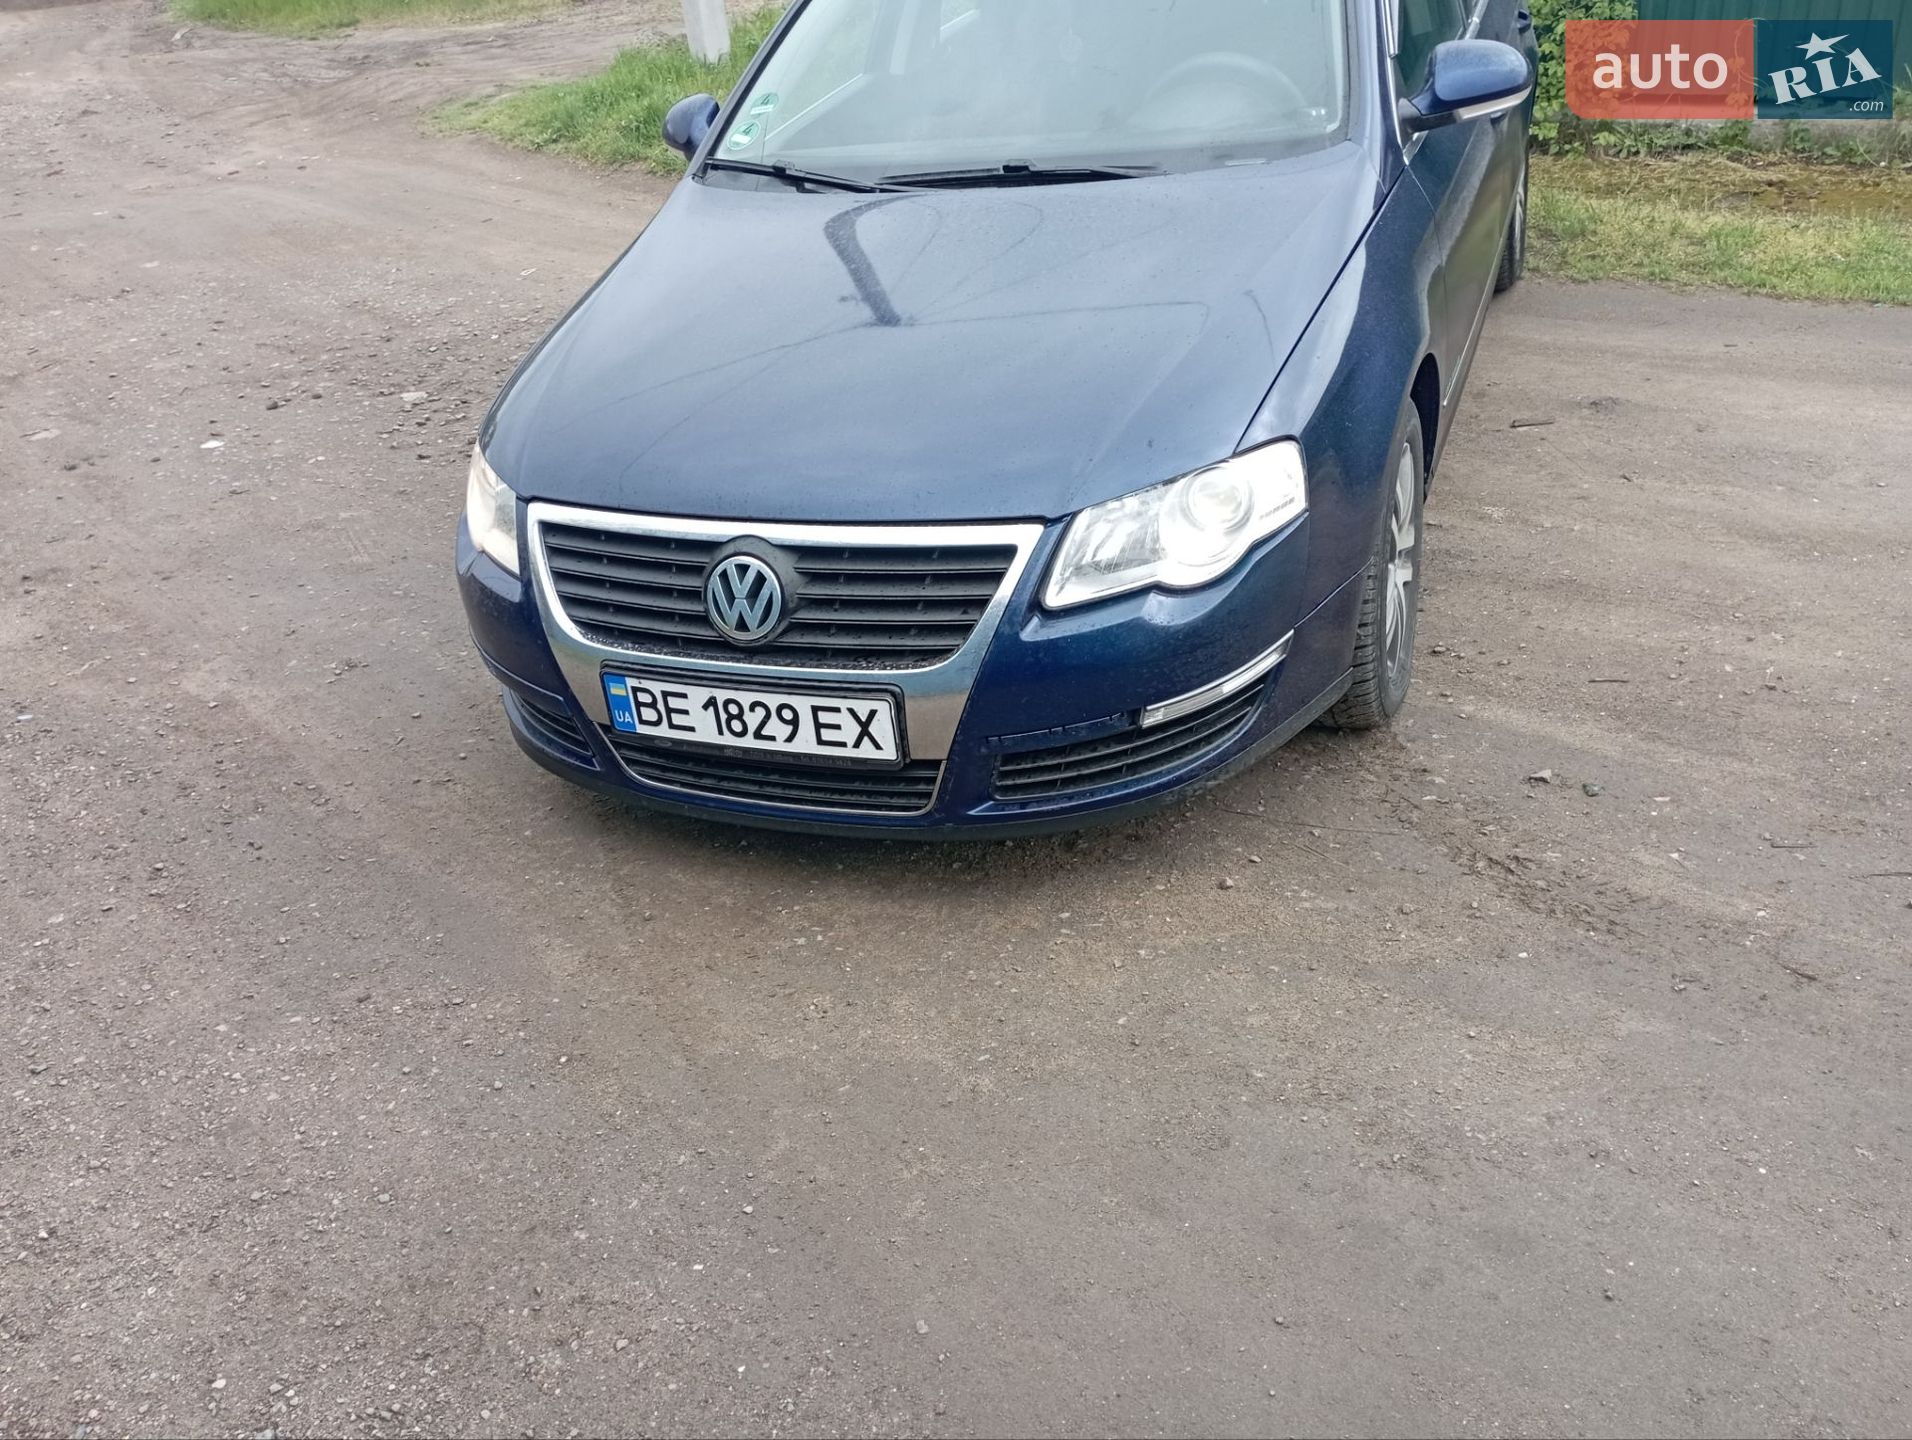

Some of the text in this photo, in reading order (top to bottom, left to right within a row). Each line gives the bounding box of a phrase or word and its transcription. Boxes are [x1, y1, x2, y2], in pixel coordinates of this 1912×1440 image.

[614, 709, 633, 724] UA
[630, 685, 884, 751] BE 1829 EX
